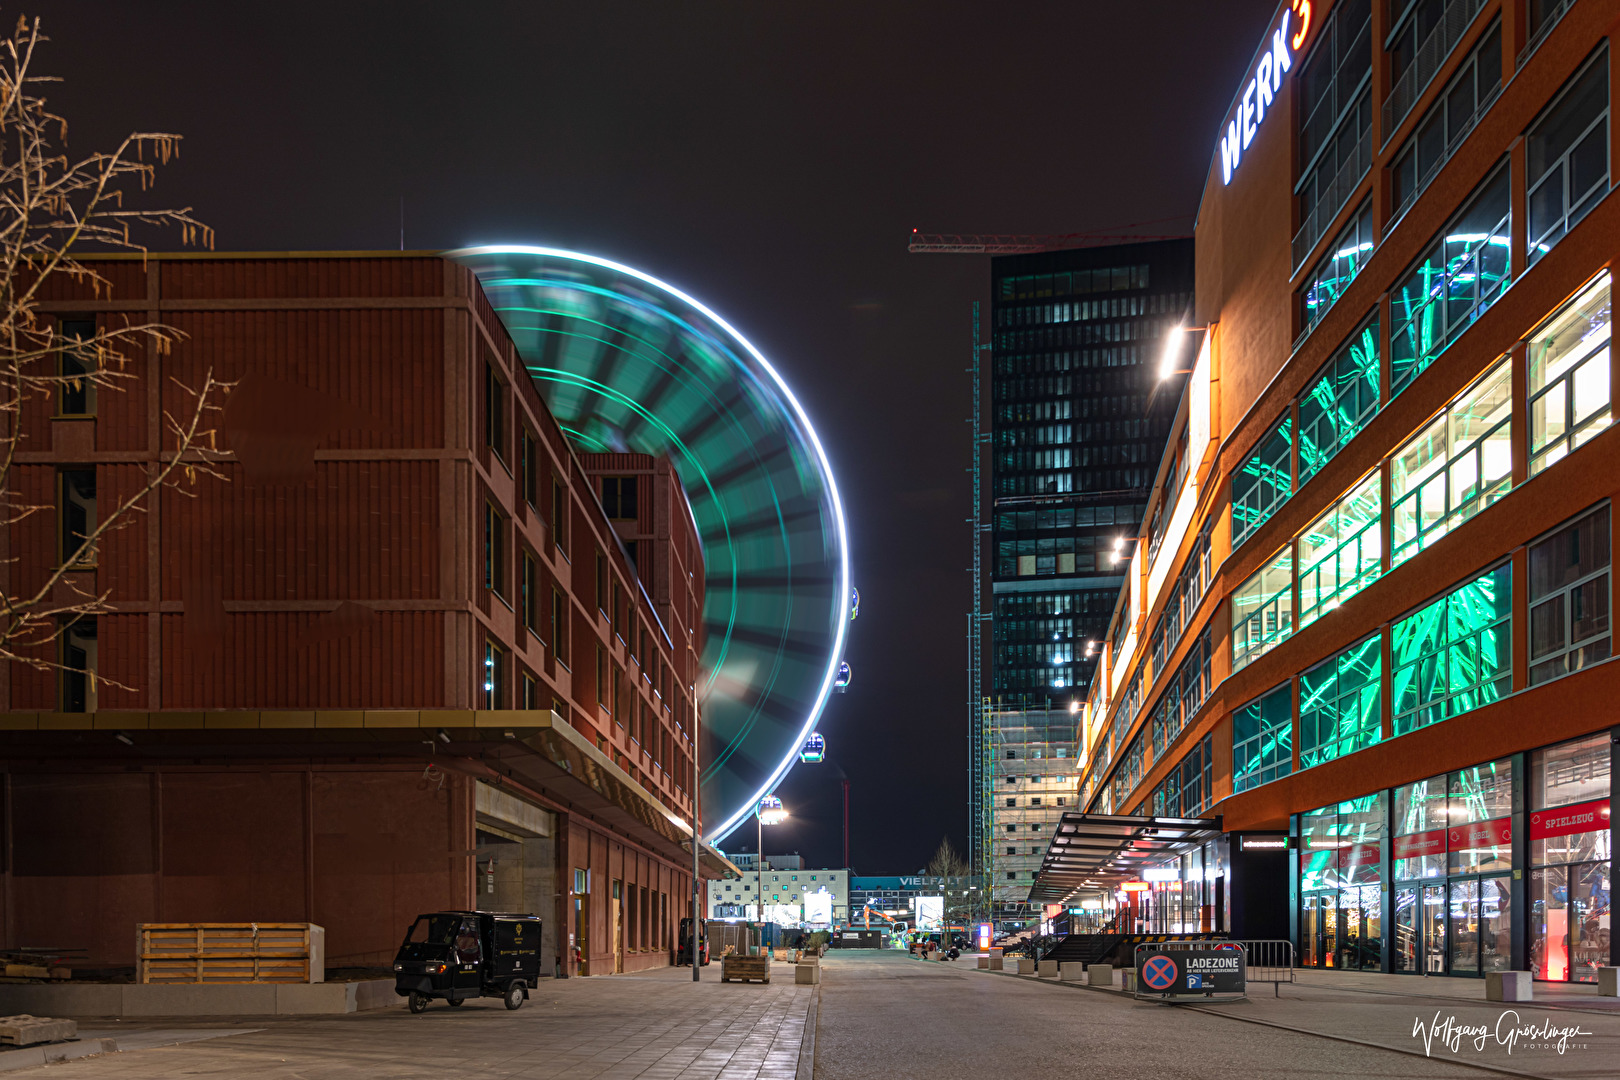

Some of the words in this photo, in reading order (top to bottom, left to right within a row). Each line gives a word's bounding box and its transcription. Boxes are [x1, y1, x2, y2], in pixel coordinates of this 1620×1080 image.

[1545, 811, 1594, 829] SPIELZEUG
[899, 877, 963, 886] VIELFALT
[1186, 958, 1239, 968] LADEZONE
[1188, 978, 1196, 988] P
